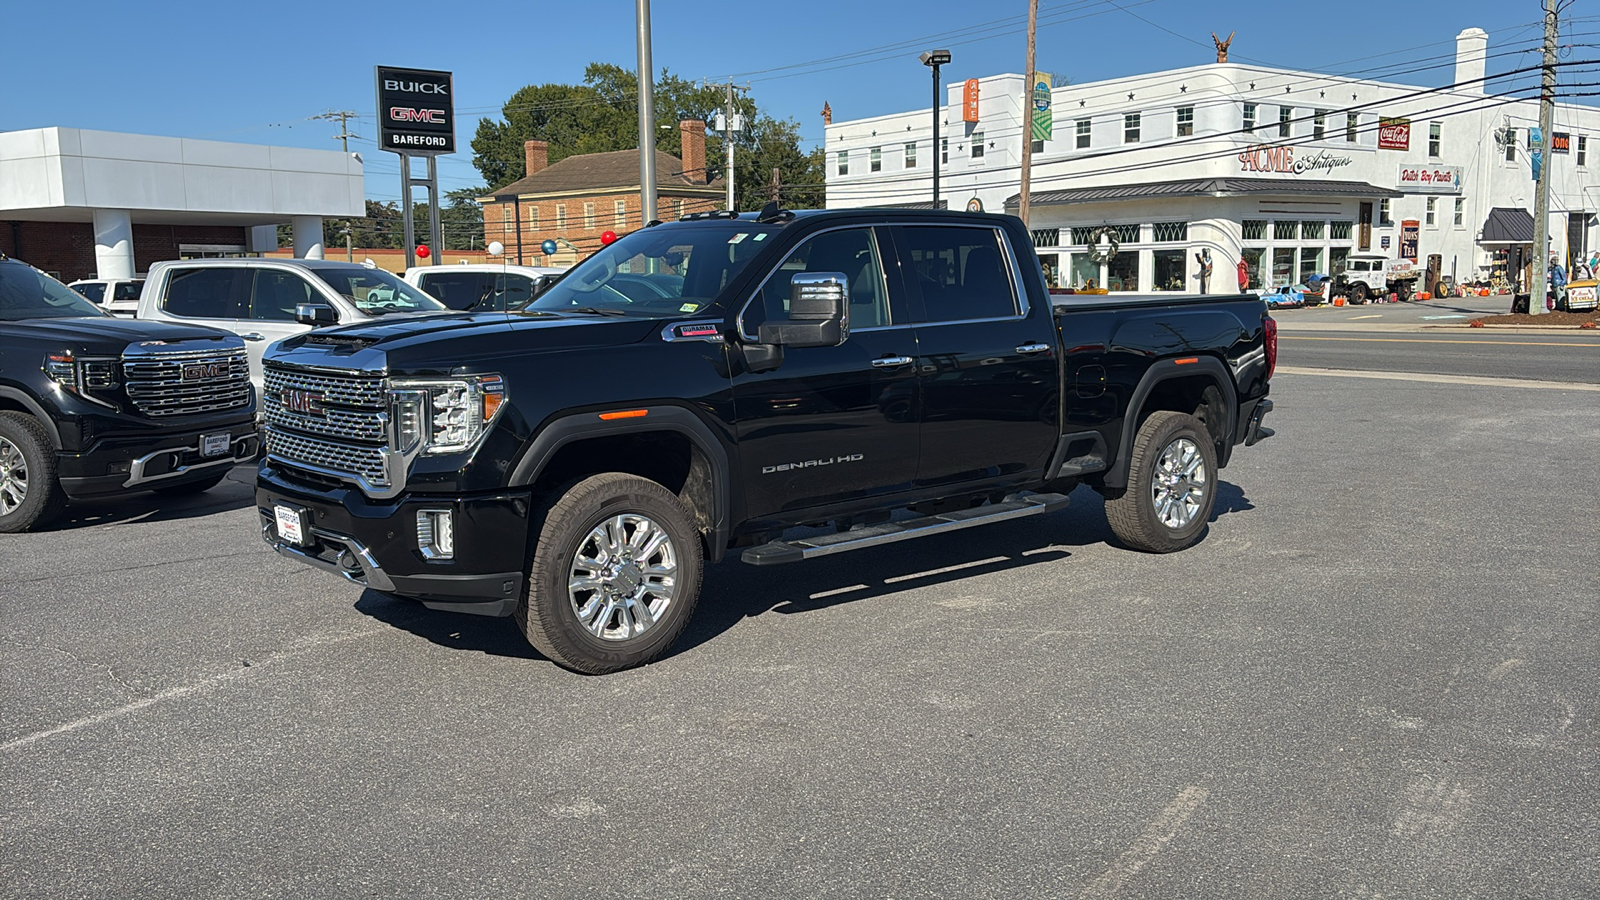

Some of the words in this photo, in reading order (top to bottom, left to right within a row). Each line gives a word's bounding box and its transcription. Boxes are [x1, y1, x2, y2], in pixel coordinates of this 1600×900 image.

[384, 80, 448, 95] BUICK
[390, 106, 445, 124] GMC
[393, 134, 446, 146] BAREFORD
[1238, 144, 1294, 173] ACME
[1402, 169, 1419, 181] Dutch
[1421, 170, 1433, 184] Boy
[1433, 170, 1452, 183] Paints
[1403, 245, 1416, 257] TEA
[682, 325, 714, 333] DURAMAX
[185, 363, 228, 379] GMC
[280, 389, 326, 415] GMC
[206, 436, 228, 445] BAREFORD
[762, 457, 834, 474] DENALI
[837, 453, 864, 463] HD
[277, 510, 299, 525] BAREFORD
